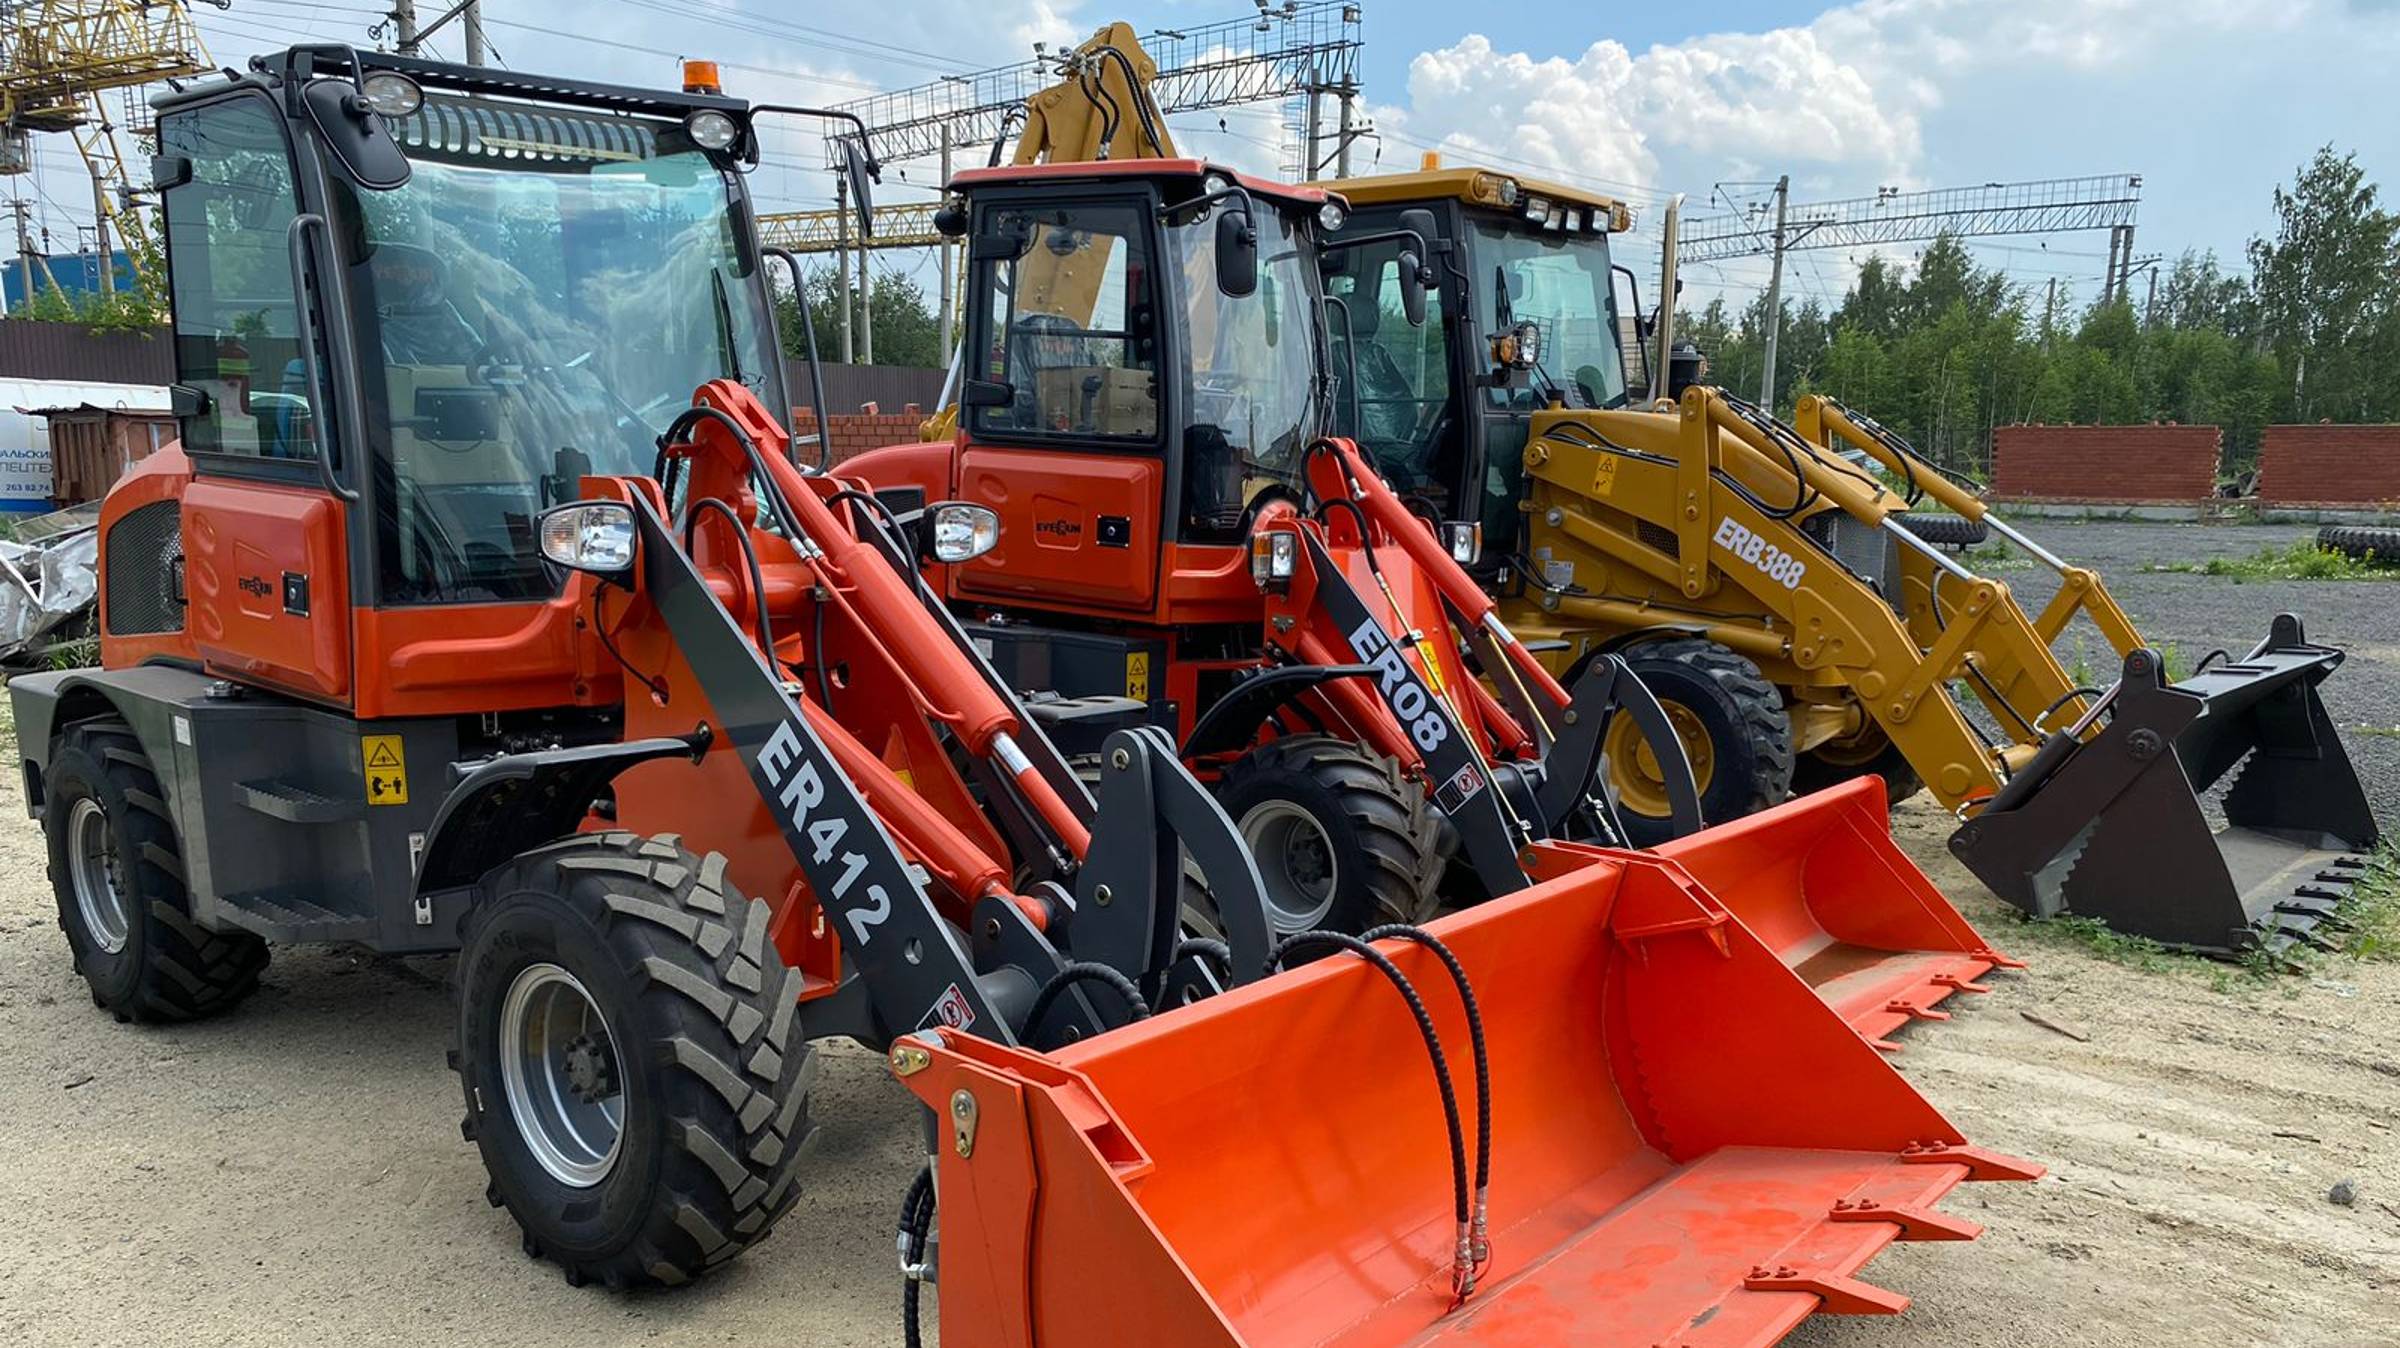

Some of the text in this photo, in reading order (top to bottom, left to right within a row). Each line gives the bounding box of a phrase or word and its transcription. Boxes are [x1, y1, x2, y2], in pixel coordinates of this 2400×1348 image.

[0, 449, 51, 458] АЛЬСКИ
[1712, 516, 1806, 589] ERB388
[1349, 617, 1448, 752] ER08
[756, 719, 892, 946] ER412
